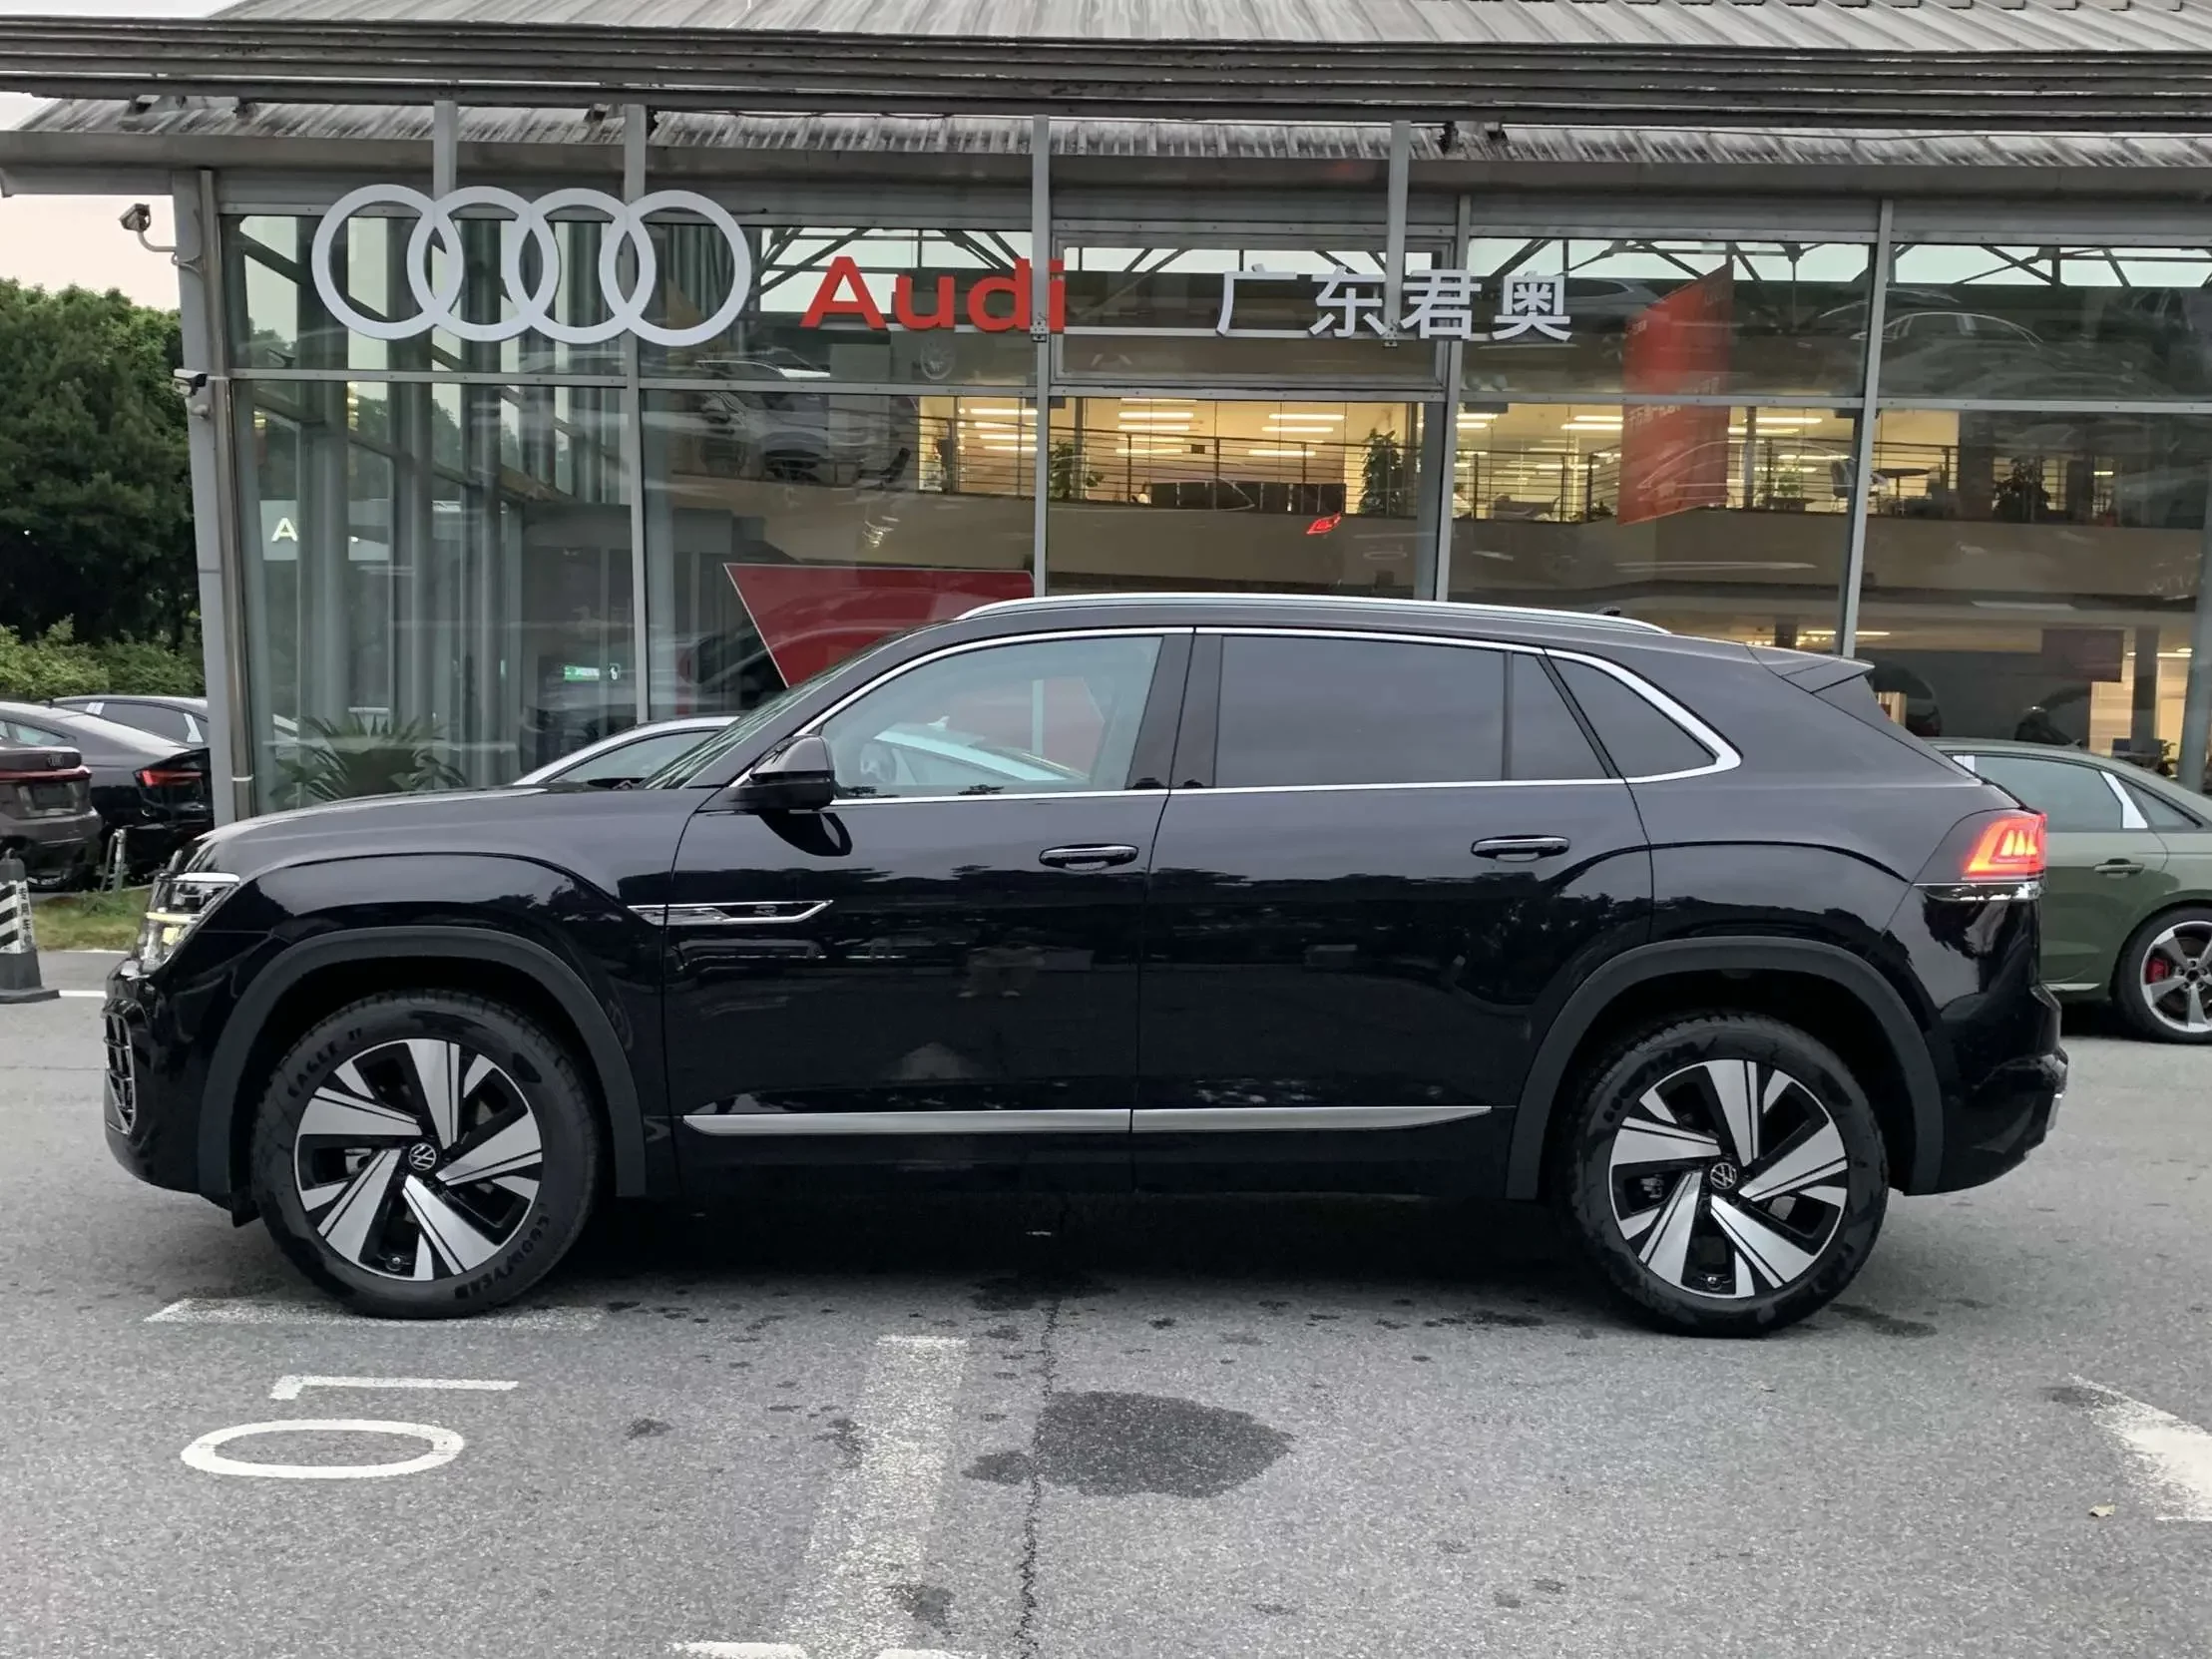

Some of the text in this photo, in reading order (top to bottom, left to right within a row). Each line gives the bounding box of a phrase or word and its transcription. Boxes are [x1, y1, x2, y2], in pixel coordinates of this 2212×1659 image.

[799, 256, 1066, 333] Audi
[1215, 263, 1572, 341] 广东君奥
